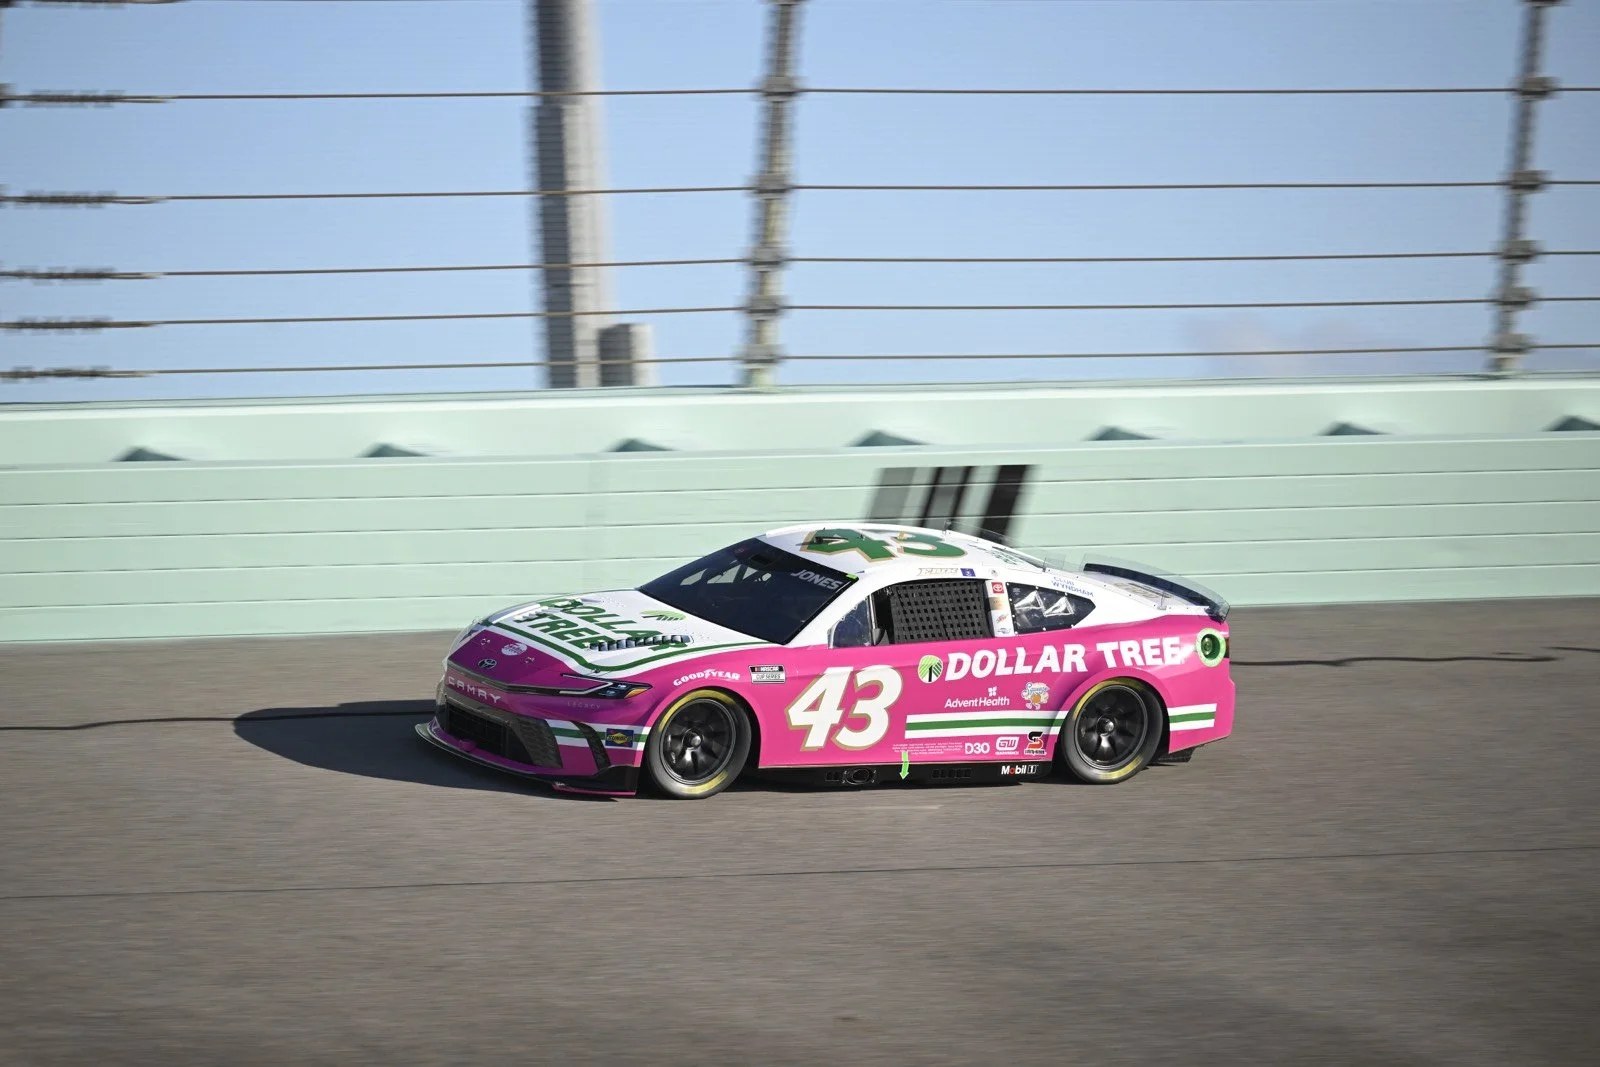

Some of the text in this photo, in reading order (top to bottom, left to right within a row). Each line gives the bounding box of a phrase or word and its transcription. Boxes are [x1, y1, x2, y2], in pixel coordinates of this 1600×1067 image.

[799, 528, 968, 562] 43
[791, 569, 843, 590] JONES
[1051, 580, 1095, 598] WYNDHAM
[945, 636, 1186, 682] DOLLAR TREE
[673, 668, 741, 687] GOODYEAR
[448, 676, 501, 704] CAMRY
[567, 701, 600, 709] LEGACY
[785, 665, 903, 750] 43
[1001, 764, 1027, 775] Mobil
